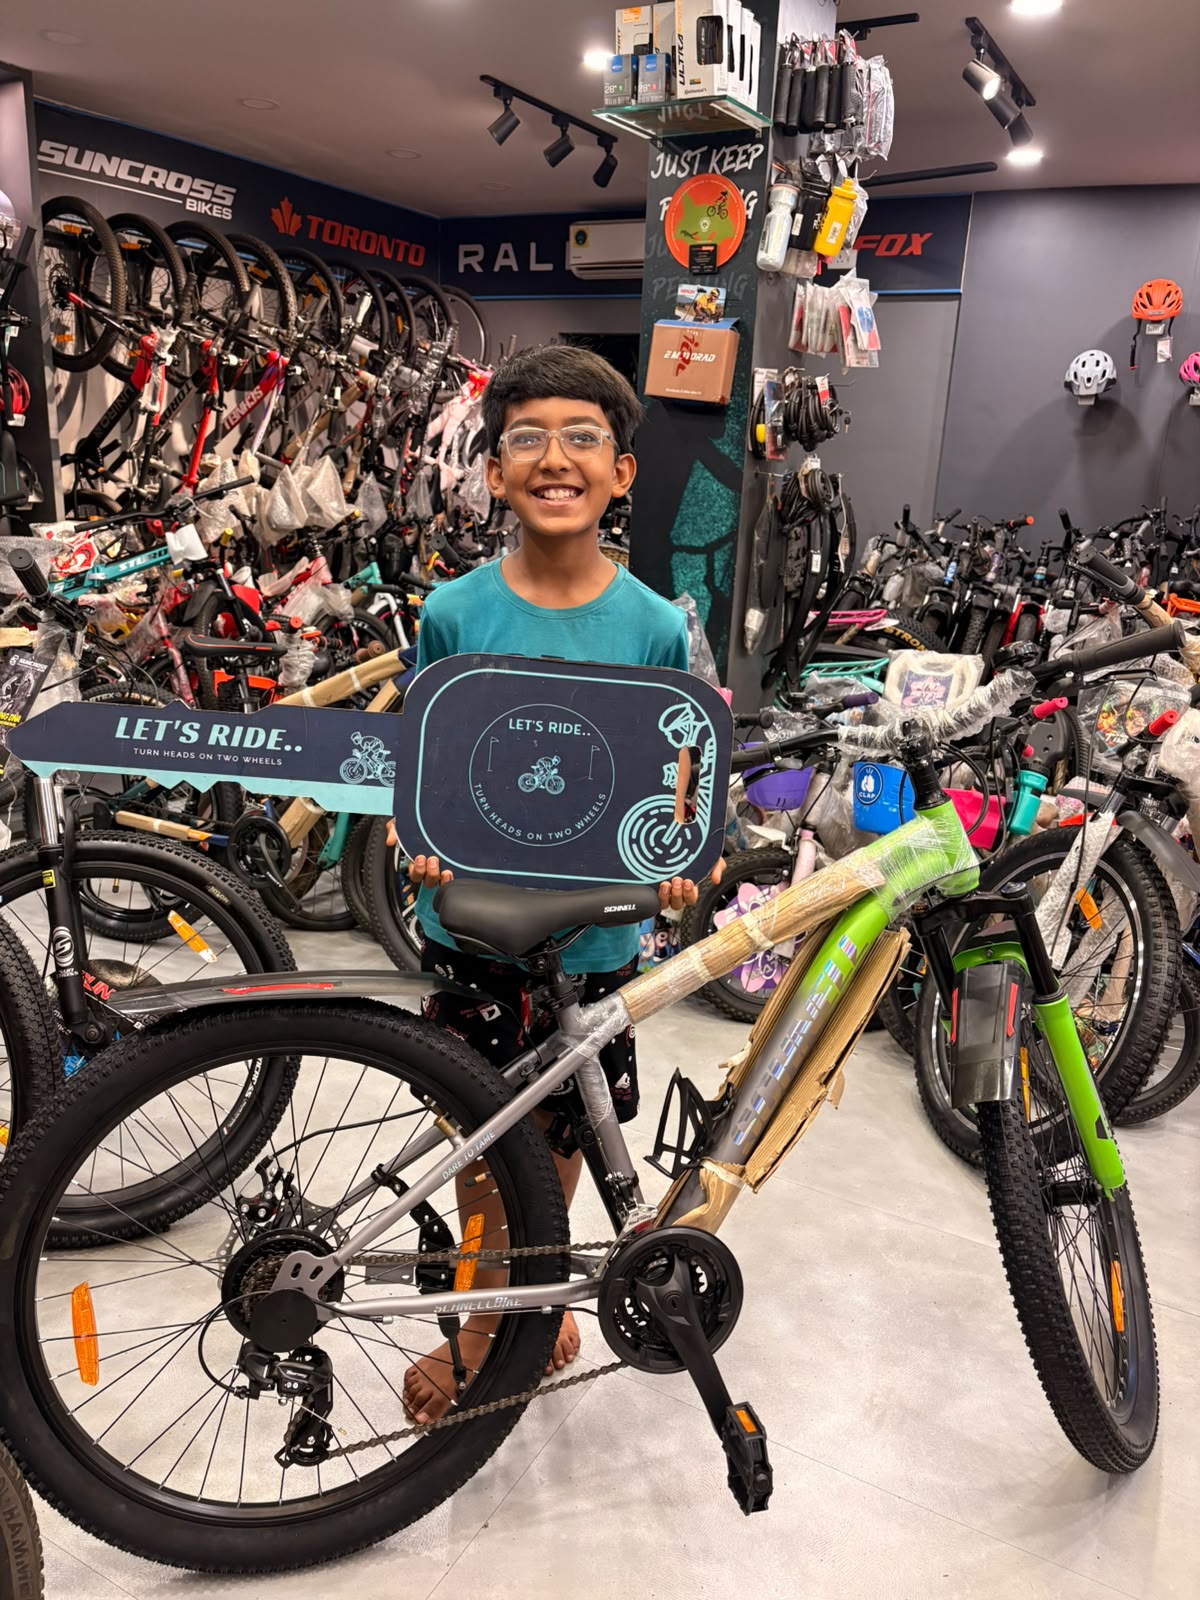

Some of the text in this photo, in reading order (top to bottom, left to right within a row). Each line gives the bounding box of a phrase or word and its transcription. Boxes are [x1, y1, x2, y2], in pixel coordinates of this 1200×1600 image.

[677, 33, 685, 86] ULTRA
[37, 139, 237, 206] SUNCROSS
[651, 143, 764, 179] JUST KEEP
[185, 198, 232, 220] BIKES
[307, 215, 426, 268] TORONTO
[853, 232, 934, 257] FOX
[458, 242, 570, 273] RAL
[883, 626, 927, 651] STRON
[115, 716, 302, 752] LET'S RIDE..
[508, 718, 544, 733] LET'S
[133, 748, 283, 766] TURN HEADS ON TWO WHEELS
[858, 791, 875, 799] CLAP
[474, 783, 607, 841] TURN HEADS ON TWO WHEELS
[603, 903, 637, 914] SCHNELL
[82, 970, 116, 1001] LIN
[441, 1129, 496, 1181] DARE TO TAME
